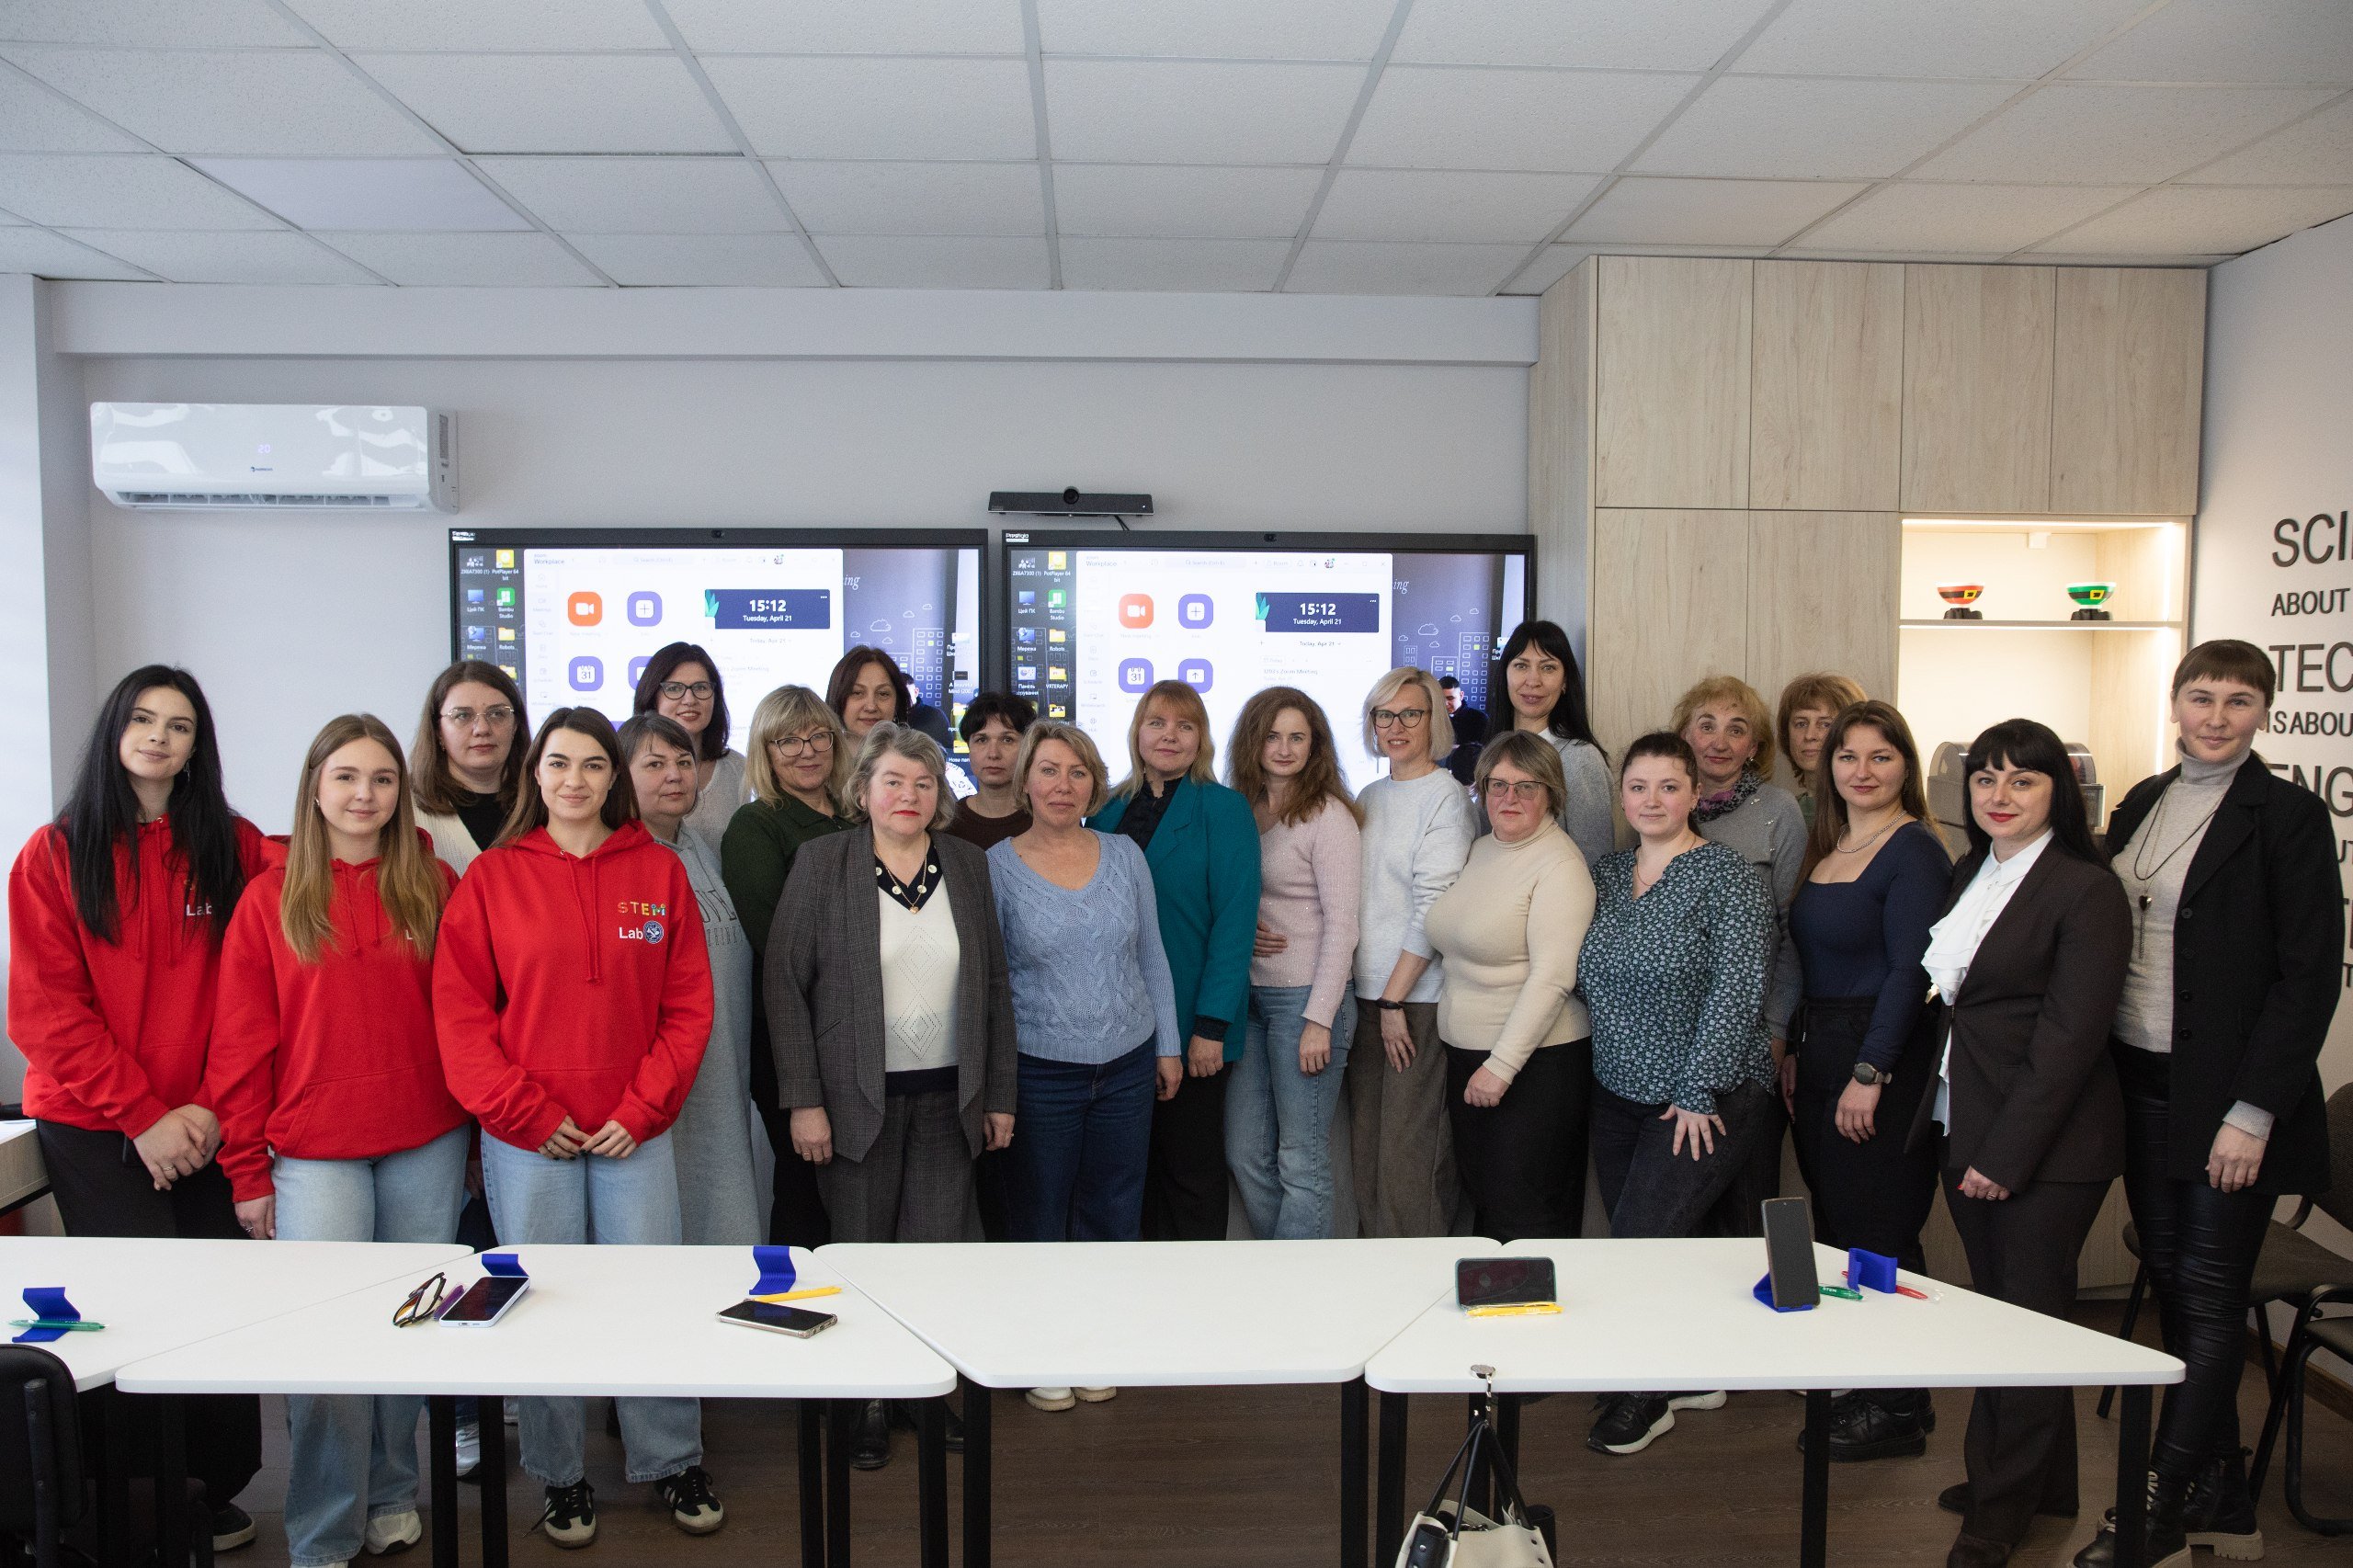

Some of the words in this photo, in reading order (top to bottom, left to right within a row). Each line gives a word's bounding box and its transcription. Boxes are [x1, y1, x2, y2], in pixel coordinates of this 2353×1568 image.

[257, 445, 270, 454] 20
[2271, 510, 2353, 568] SCI
[749, 599, 787, 612] 15:12
[2270, 587, 2351, 617] ABOUT
[1300, 603, 1336, 616] 15:12
[2268, 642, 2353, 692] TEC
[581, 671, 592, 680] 31
[1131, 673, 1142, 682] 31
[2289, 710, 2353, 737] ABOU
[617, 901, 666, 916] STEM
[619, 926, 644, 940] Lab
